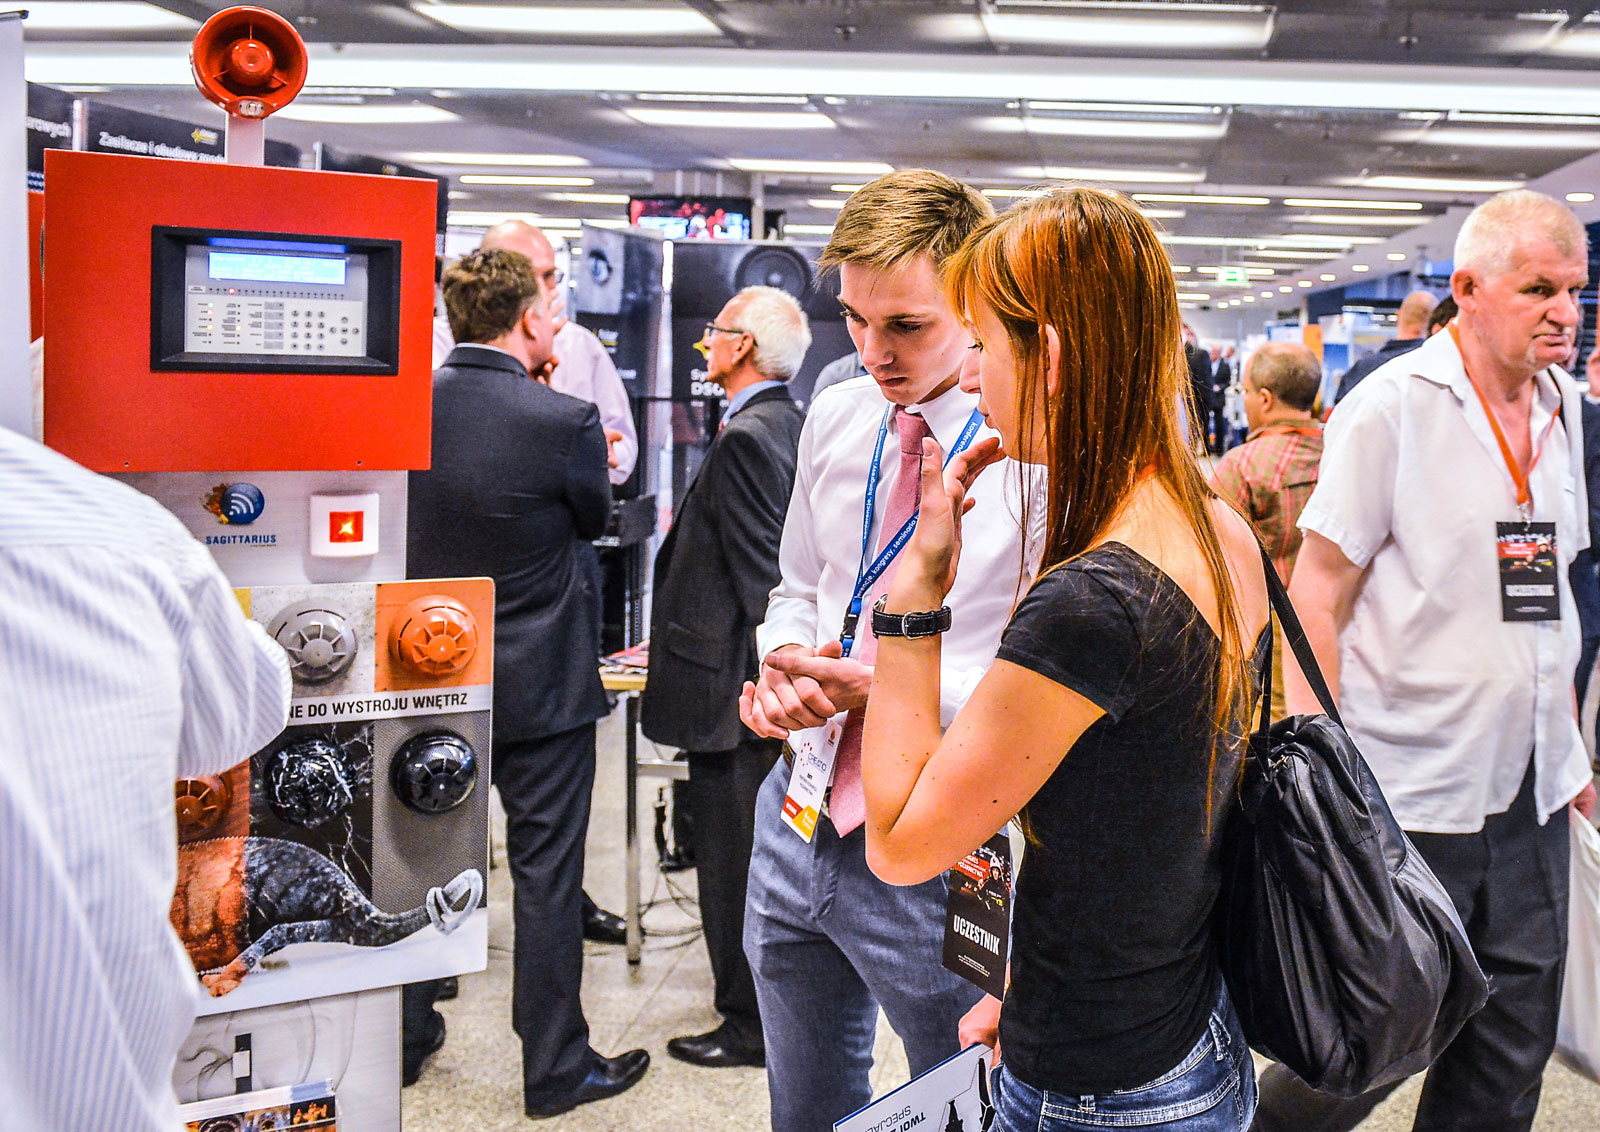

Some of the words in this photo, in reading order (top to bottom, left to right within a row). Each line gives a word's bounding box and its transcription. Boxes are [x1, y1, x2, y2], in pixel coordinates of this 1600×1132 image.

[206, 534, 277, 545] SAGITTARIUS
[871, 548, 897, 575] kongresy,
[893, 519, 917, 549] seminaria
[308, 703, 327, 717] DO
[332, 698, 408, 715] WYSTROJU
[412, 693, 468, 710] WNĘTRZ
[953, 914, 1000, 956] UCZESTNIK
